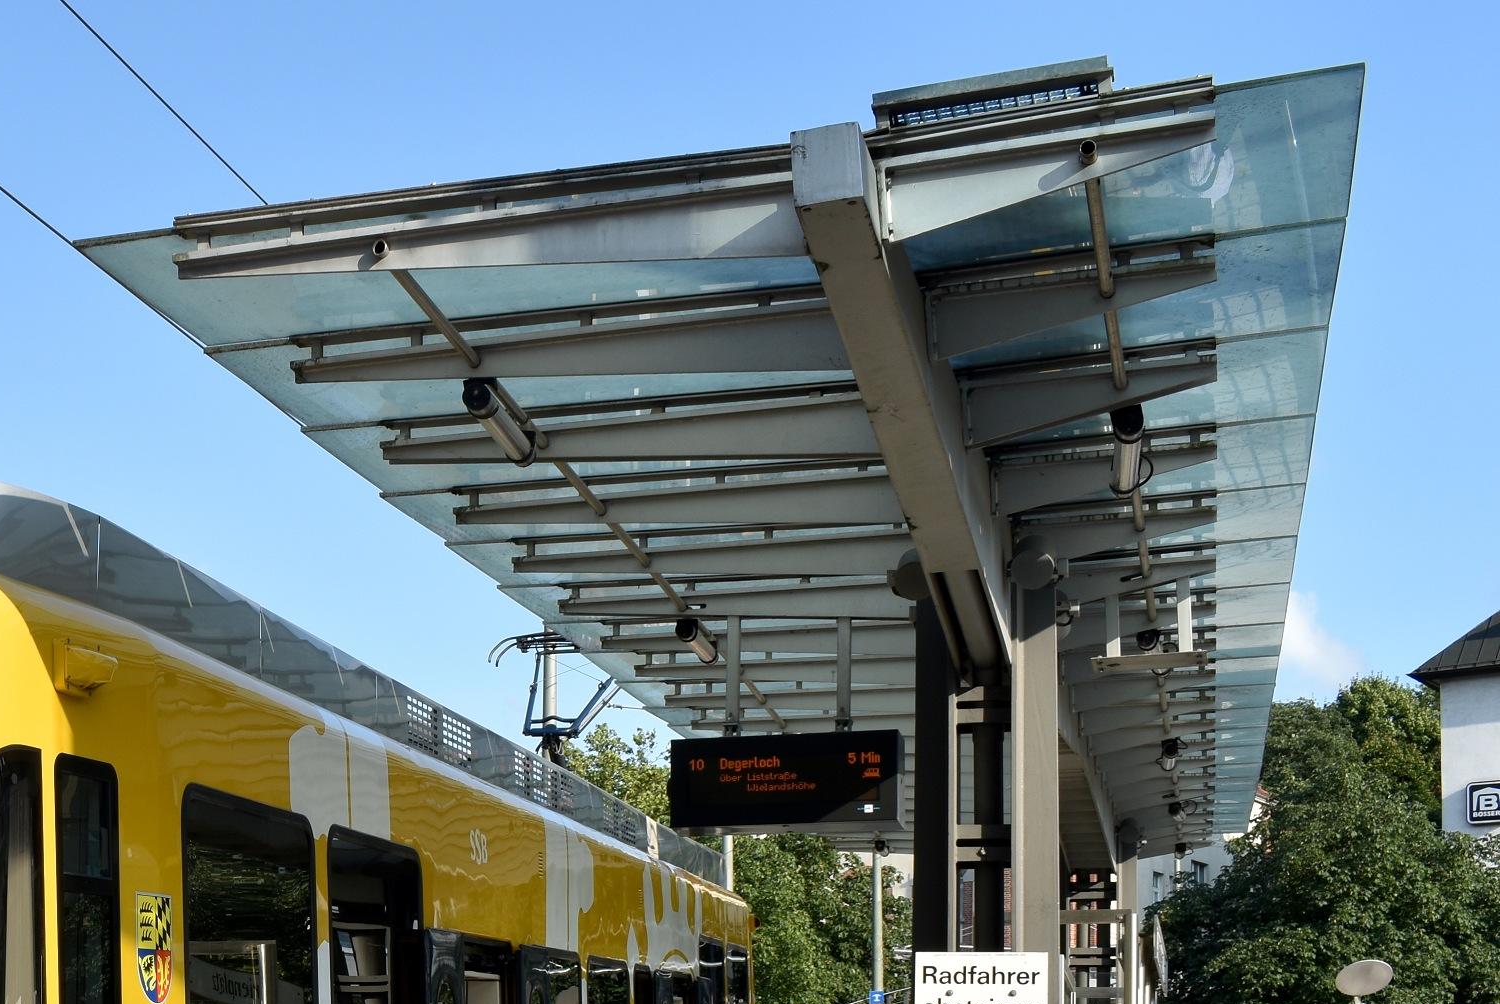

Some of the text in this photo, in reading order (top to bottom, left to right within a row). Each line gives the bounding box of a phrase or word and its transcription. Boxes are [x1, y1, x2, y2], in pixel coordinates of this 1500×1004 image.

[688, 751, 881, 772] 10 Degerloch 5 Min
[470, 828, 488, 865] SSB
[922, 965, 1041, 985] Radfahrer
